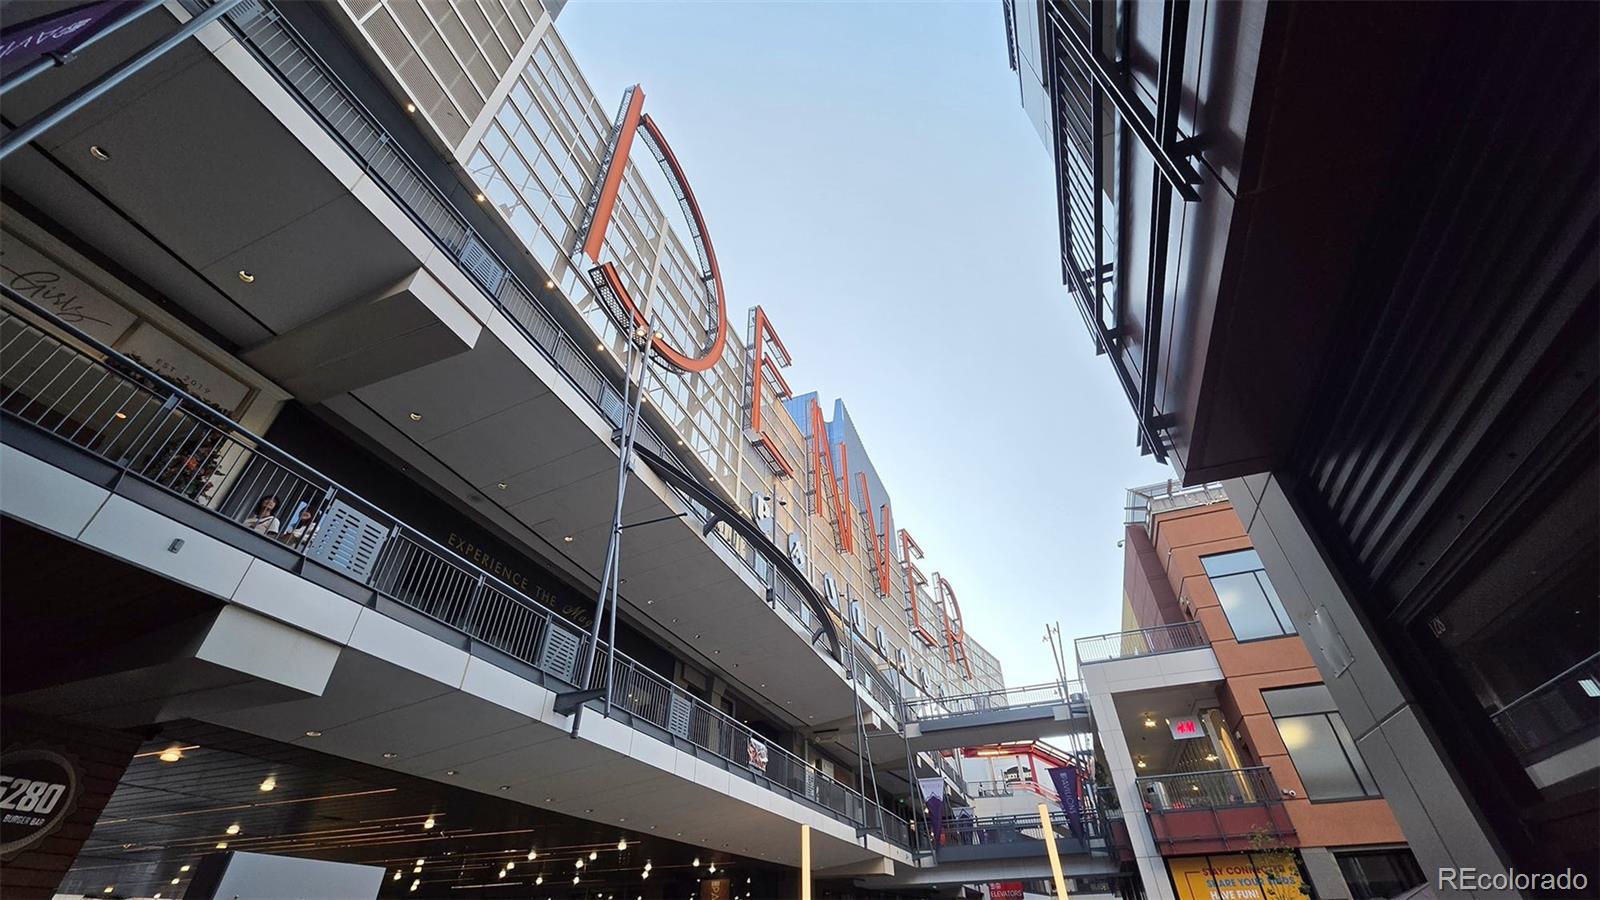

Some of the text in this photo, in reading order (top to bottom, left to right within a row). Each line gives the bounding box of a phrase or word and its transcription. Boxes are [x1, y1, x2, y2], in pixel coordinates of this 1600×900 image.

[572, 83, 972, 681] DENVER
[447, 532, 529, 590] EXPERIENCE
[536, 585, 558, 608] THE
[1237, 876, 1265, 887] YOUR
[990, 889, 1022, 898] ELEVATORS
[1237, 889, 1260, 899] FUN!
